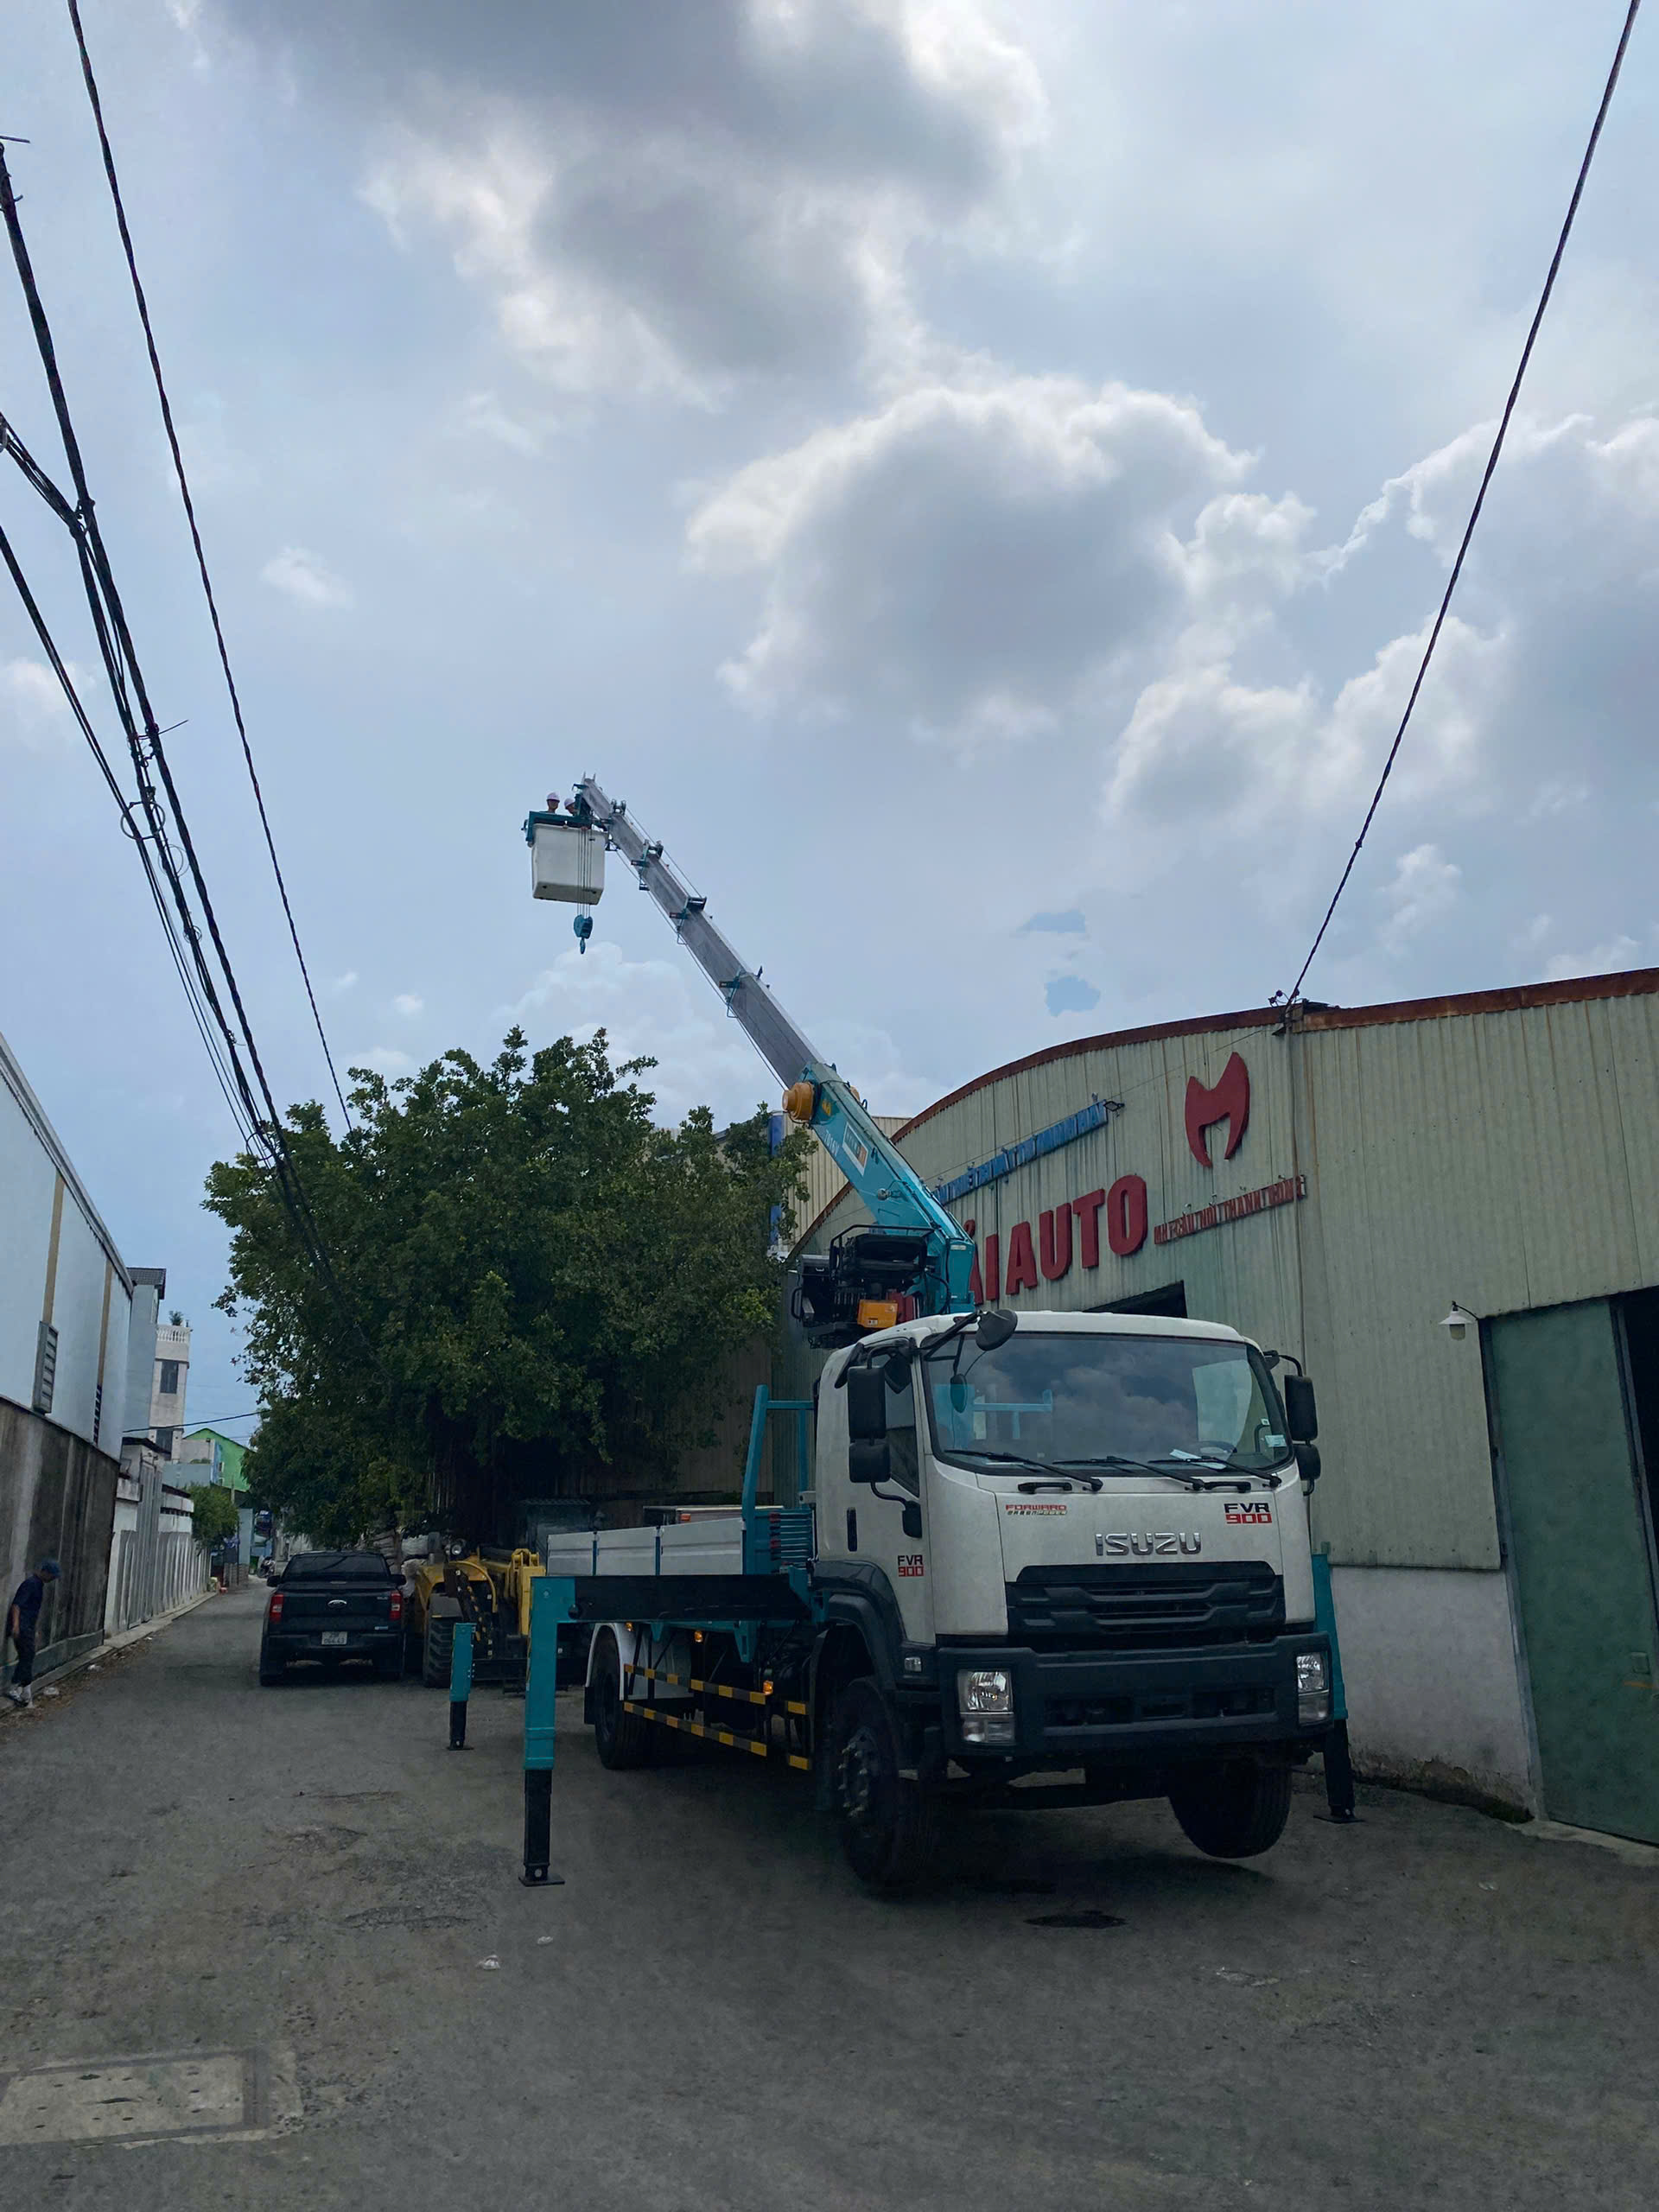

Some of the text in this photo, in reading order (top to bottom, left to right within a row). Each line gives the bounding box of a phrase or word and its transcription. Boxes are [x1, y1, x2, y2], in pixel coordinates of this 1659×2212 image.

[1006, 1174, 1147, 1296] AUTO
[1224, 1503, 1270, 1513] FVR
[1225, 1513, 1273, 1524] 900
[1095, 1532, 1202, 1556] ISUZU
[898, 1554, 923, 1566] FVR
[898, 1566, 924, 1577] 900
